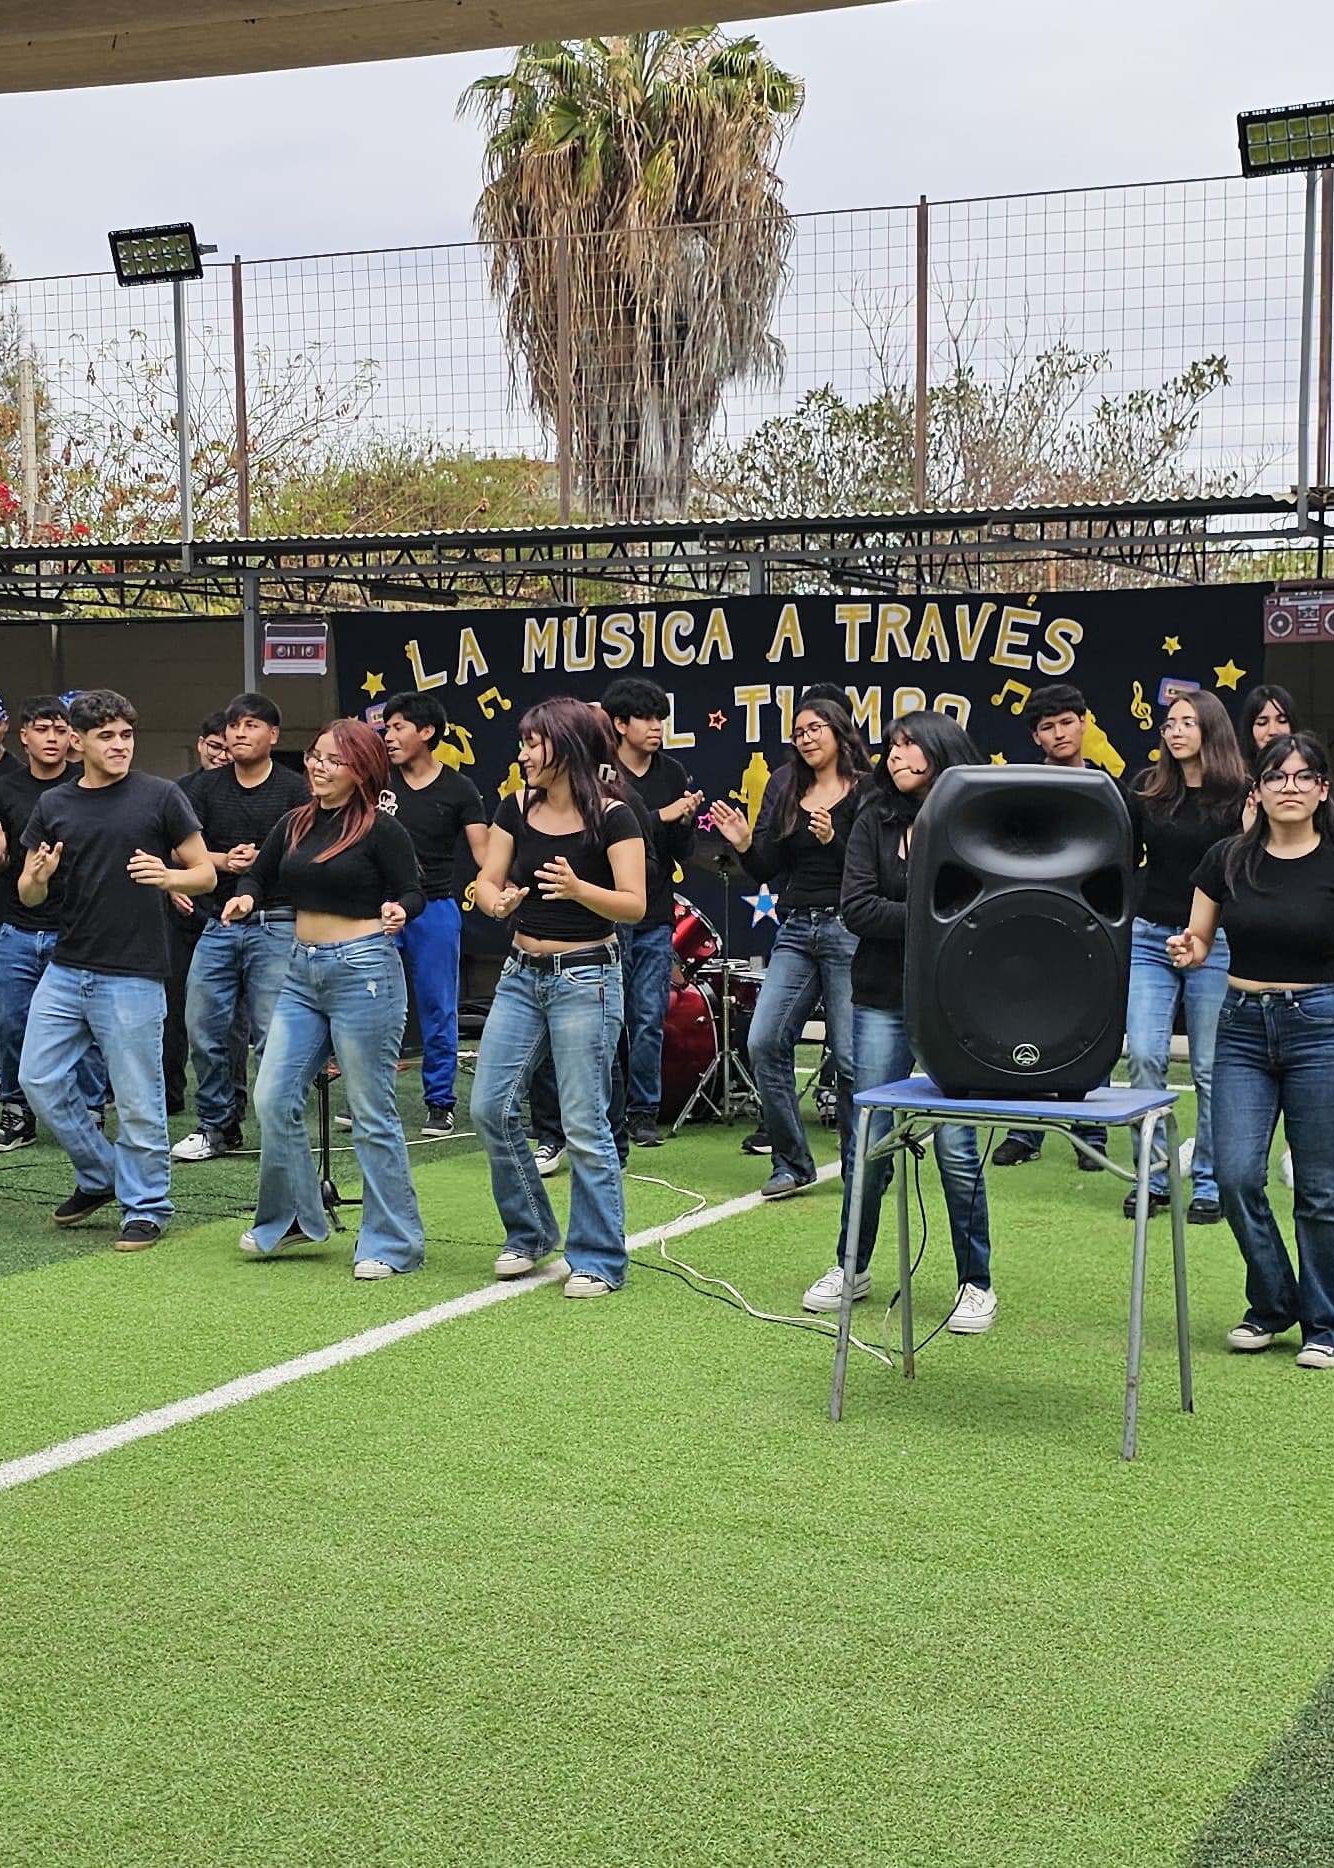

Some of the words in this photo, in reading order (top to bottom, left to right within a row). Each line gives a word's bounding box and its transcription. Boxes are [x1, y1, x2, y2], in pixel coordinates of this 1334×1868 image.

[404, 627, 489, 692] LA
[522, 606, 734, 674] MÚSICA
[765, 603, 805, 663] A
[835, 594, 1084, 676] TRAVÉS
[734, 684, 972, 745] TIMPO
